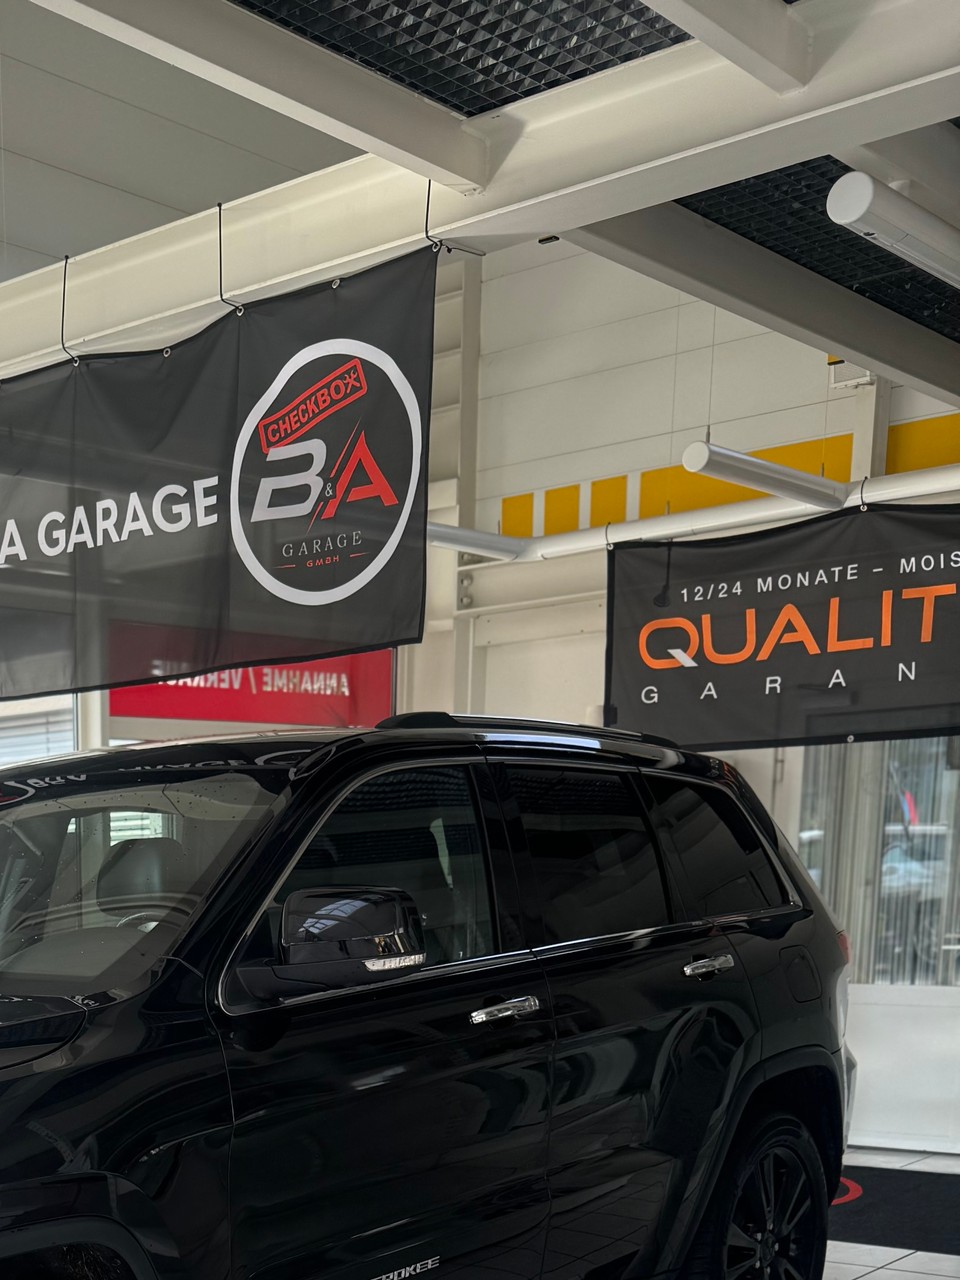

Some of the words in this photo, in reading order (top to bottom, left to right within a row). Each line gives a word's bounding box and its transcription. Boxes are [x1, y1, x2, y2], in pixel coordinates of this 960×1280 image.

[37, 475, 219, 557] GARAGE
[282, 530, 362, 558] GARAGE
[306, 555, 339, 568] GMBH
[681, 580, 743, 602] 12/24
[757, 564, 859, 593] MONATE
[899, 551, 960, 574] MOIS
[639, 583, 957, 670] QUALIT
